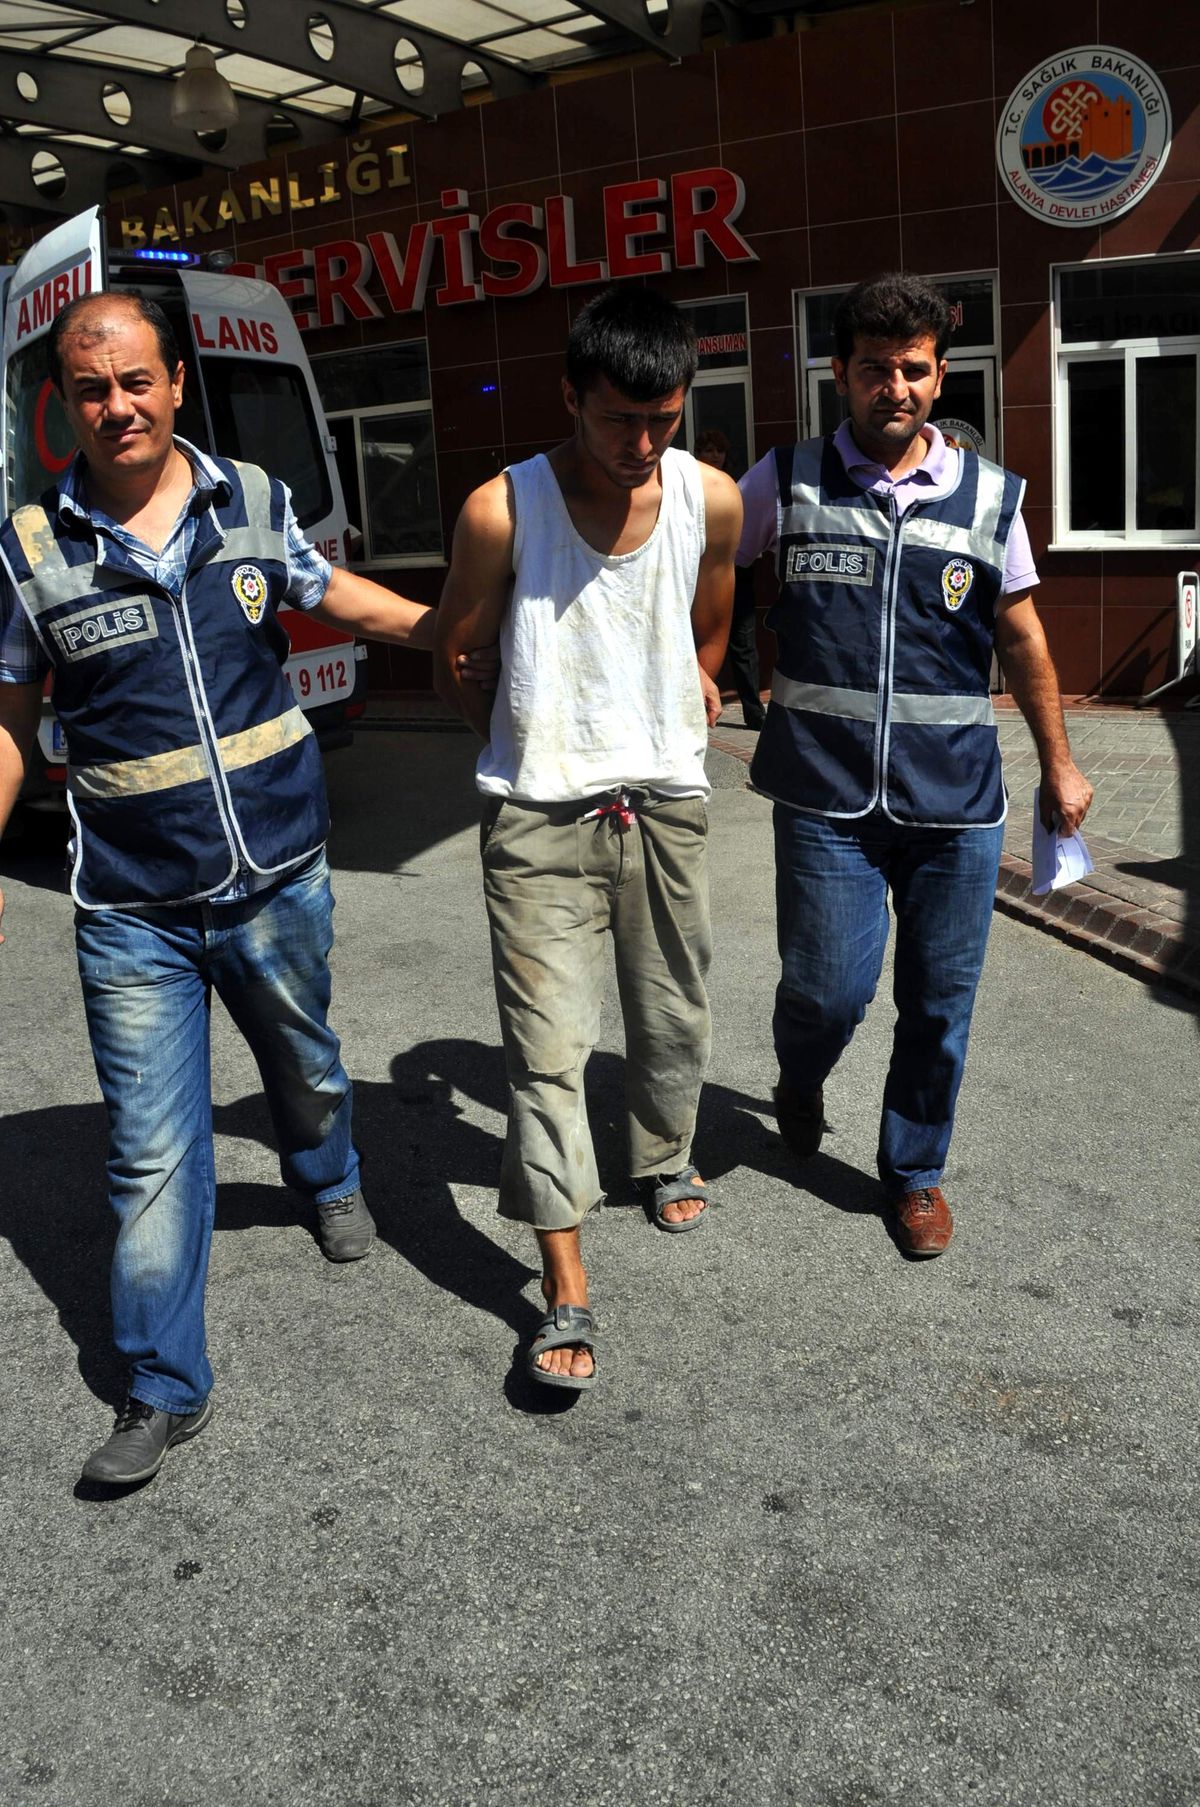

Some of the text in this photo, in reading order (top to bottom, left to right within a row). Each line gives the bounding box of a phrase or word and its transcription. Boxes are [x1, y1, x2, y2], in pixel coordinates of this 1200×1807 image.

[1005, 55, 1160, 136] T.C. SAĞLIK BAKANLIĞI
[120, 139, 411, 250] BAKANLIĞI
[1009, 169, 1046, 209] ALANYA
[1049, 203, 1098, 219] DEVLET
[225, 166, 760, 331] ERVİSLER
[192, 314, 279, 355] LANS
[316, 660, 348, 692] 112
